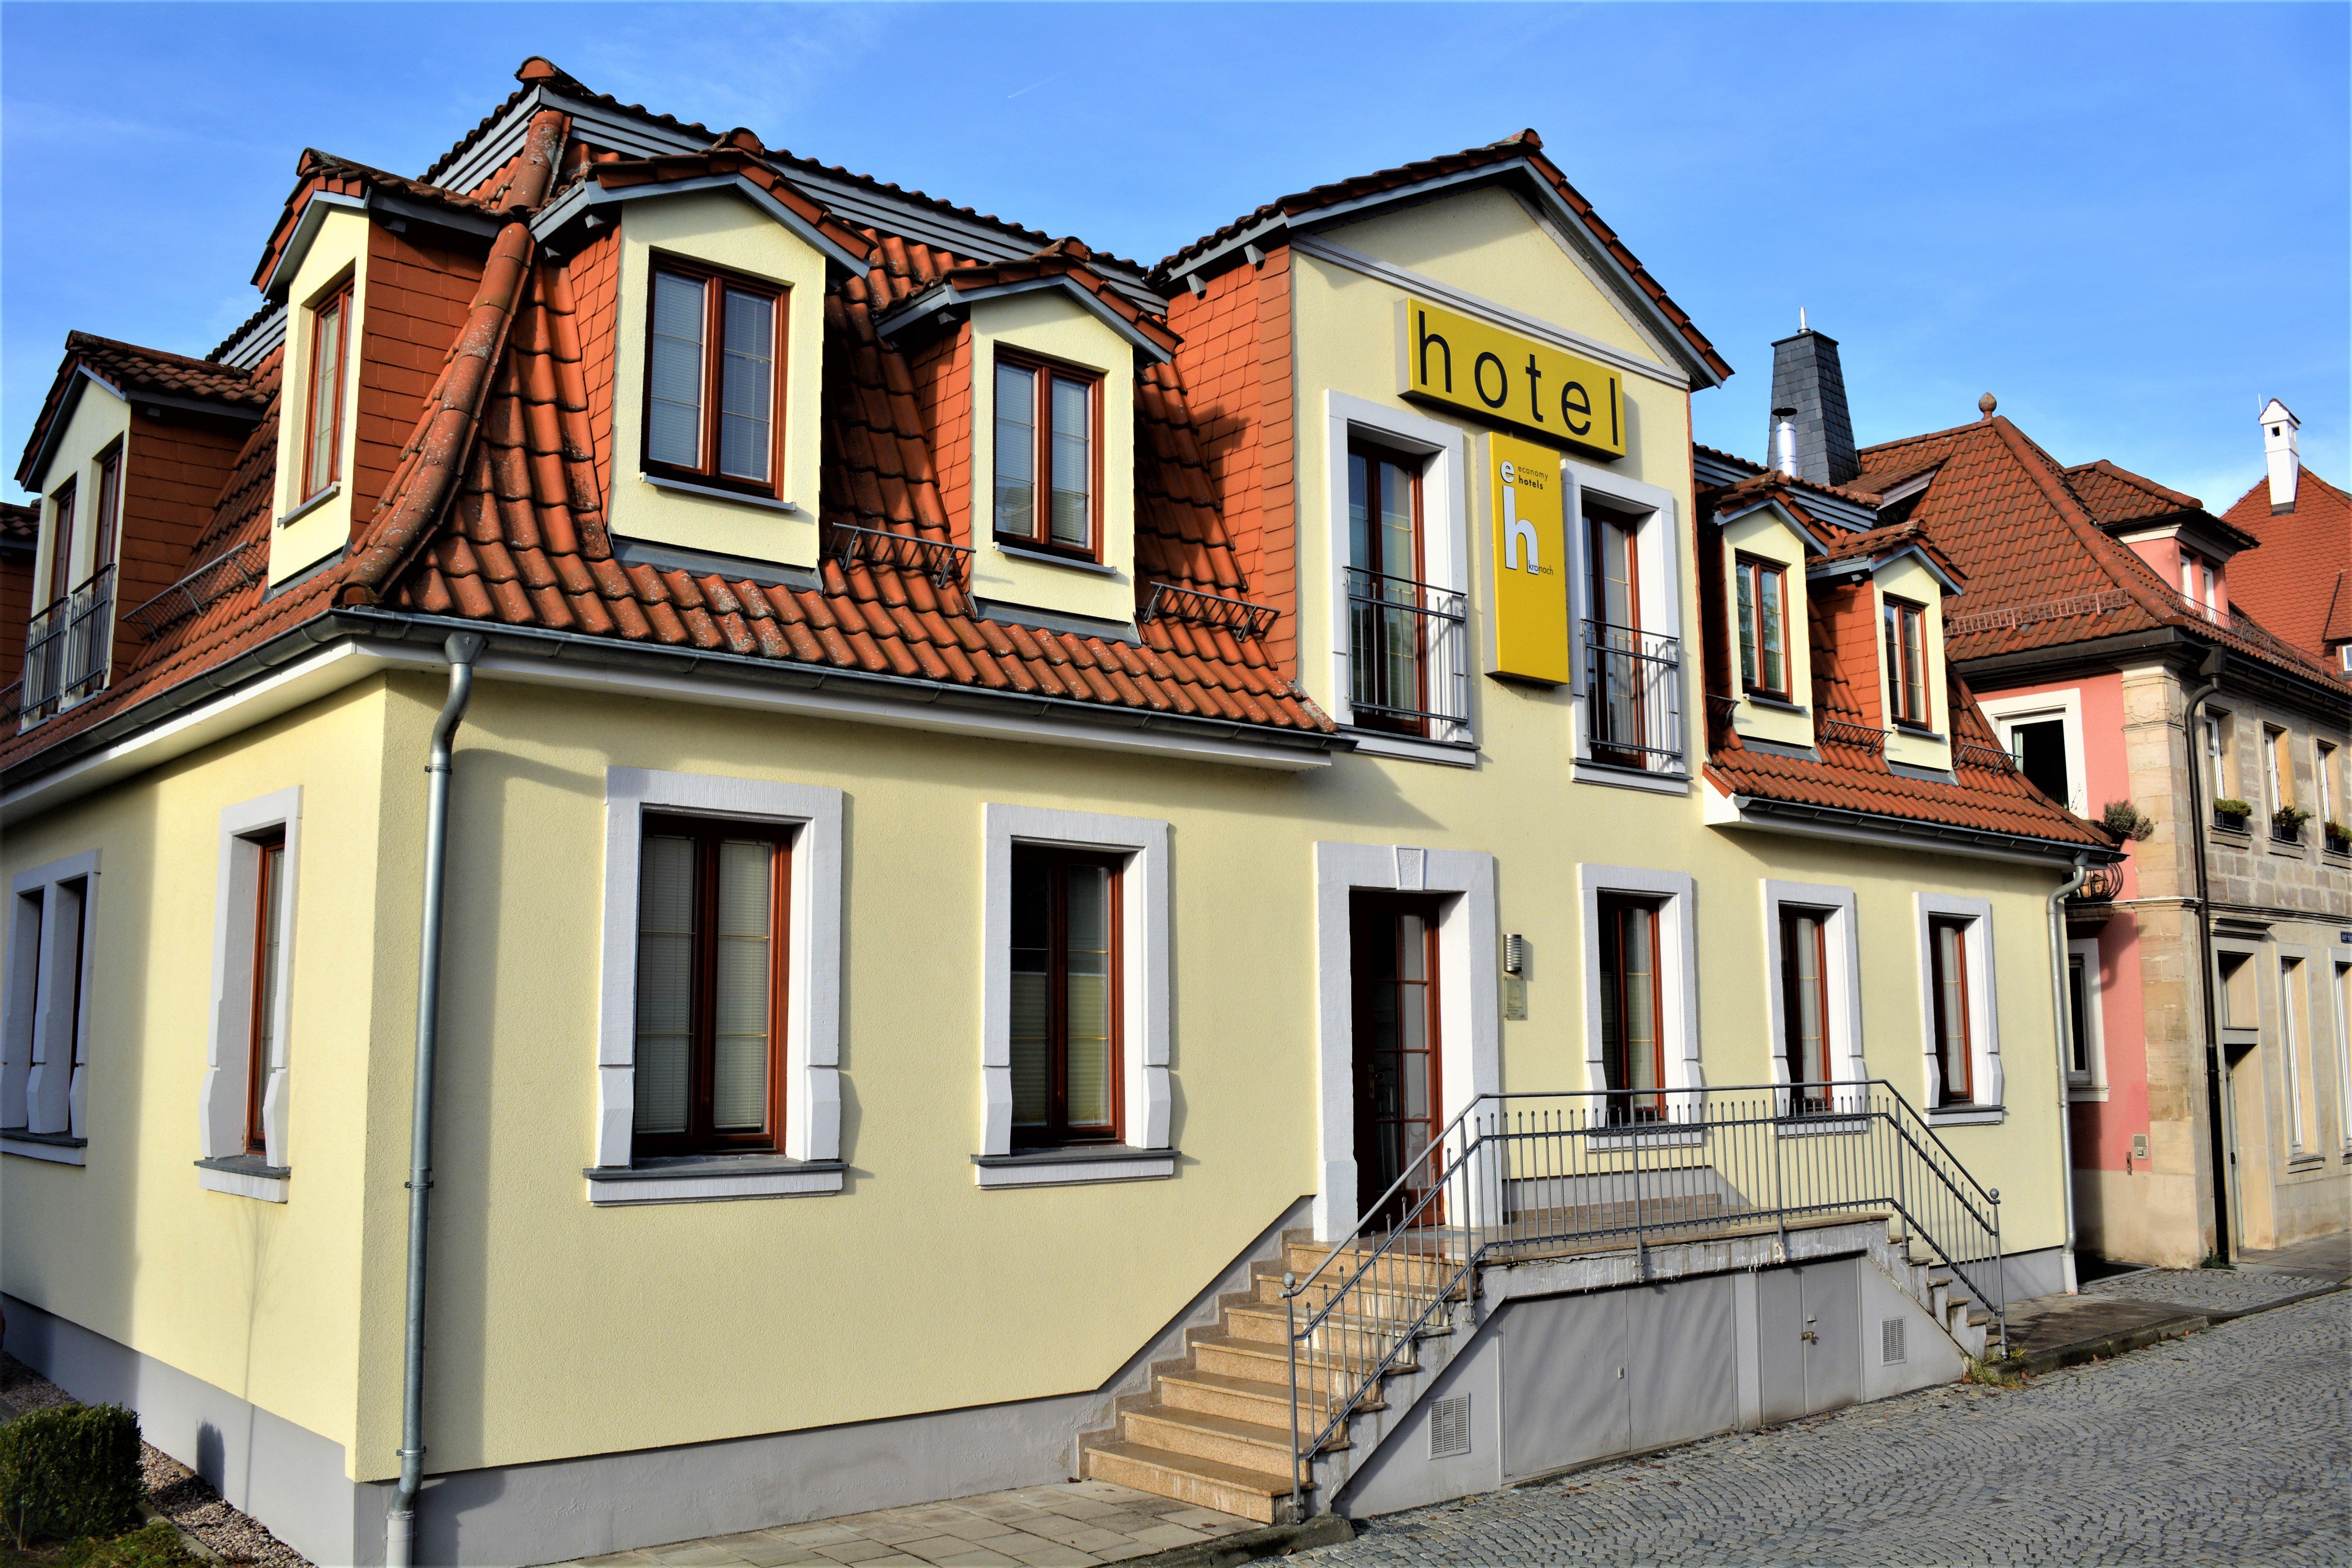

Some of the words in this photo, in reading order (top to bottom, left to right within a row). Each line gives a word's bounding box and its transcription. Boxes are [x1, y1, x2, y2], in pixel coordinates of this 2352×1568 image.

[1419, 310, 1618, 446] hotel
[1501, 461, 1515, 483] e
[1518, 466, 1548, 481] economy
[1519, 475, 1543, 489] hotels
[1503, 485, 1539, 575] h
[1528, 559, 1553, 575] kronach
